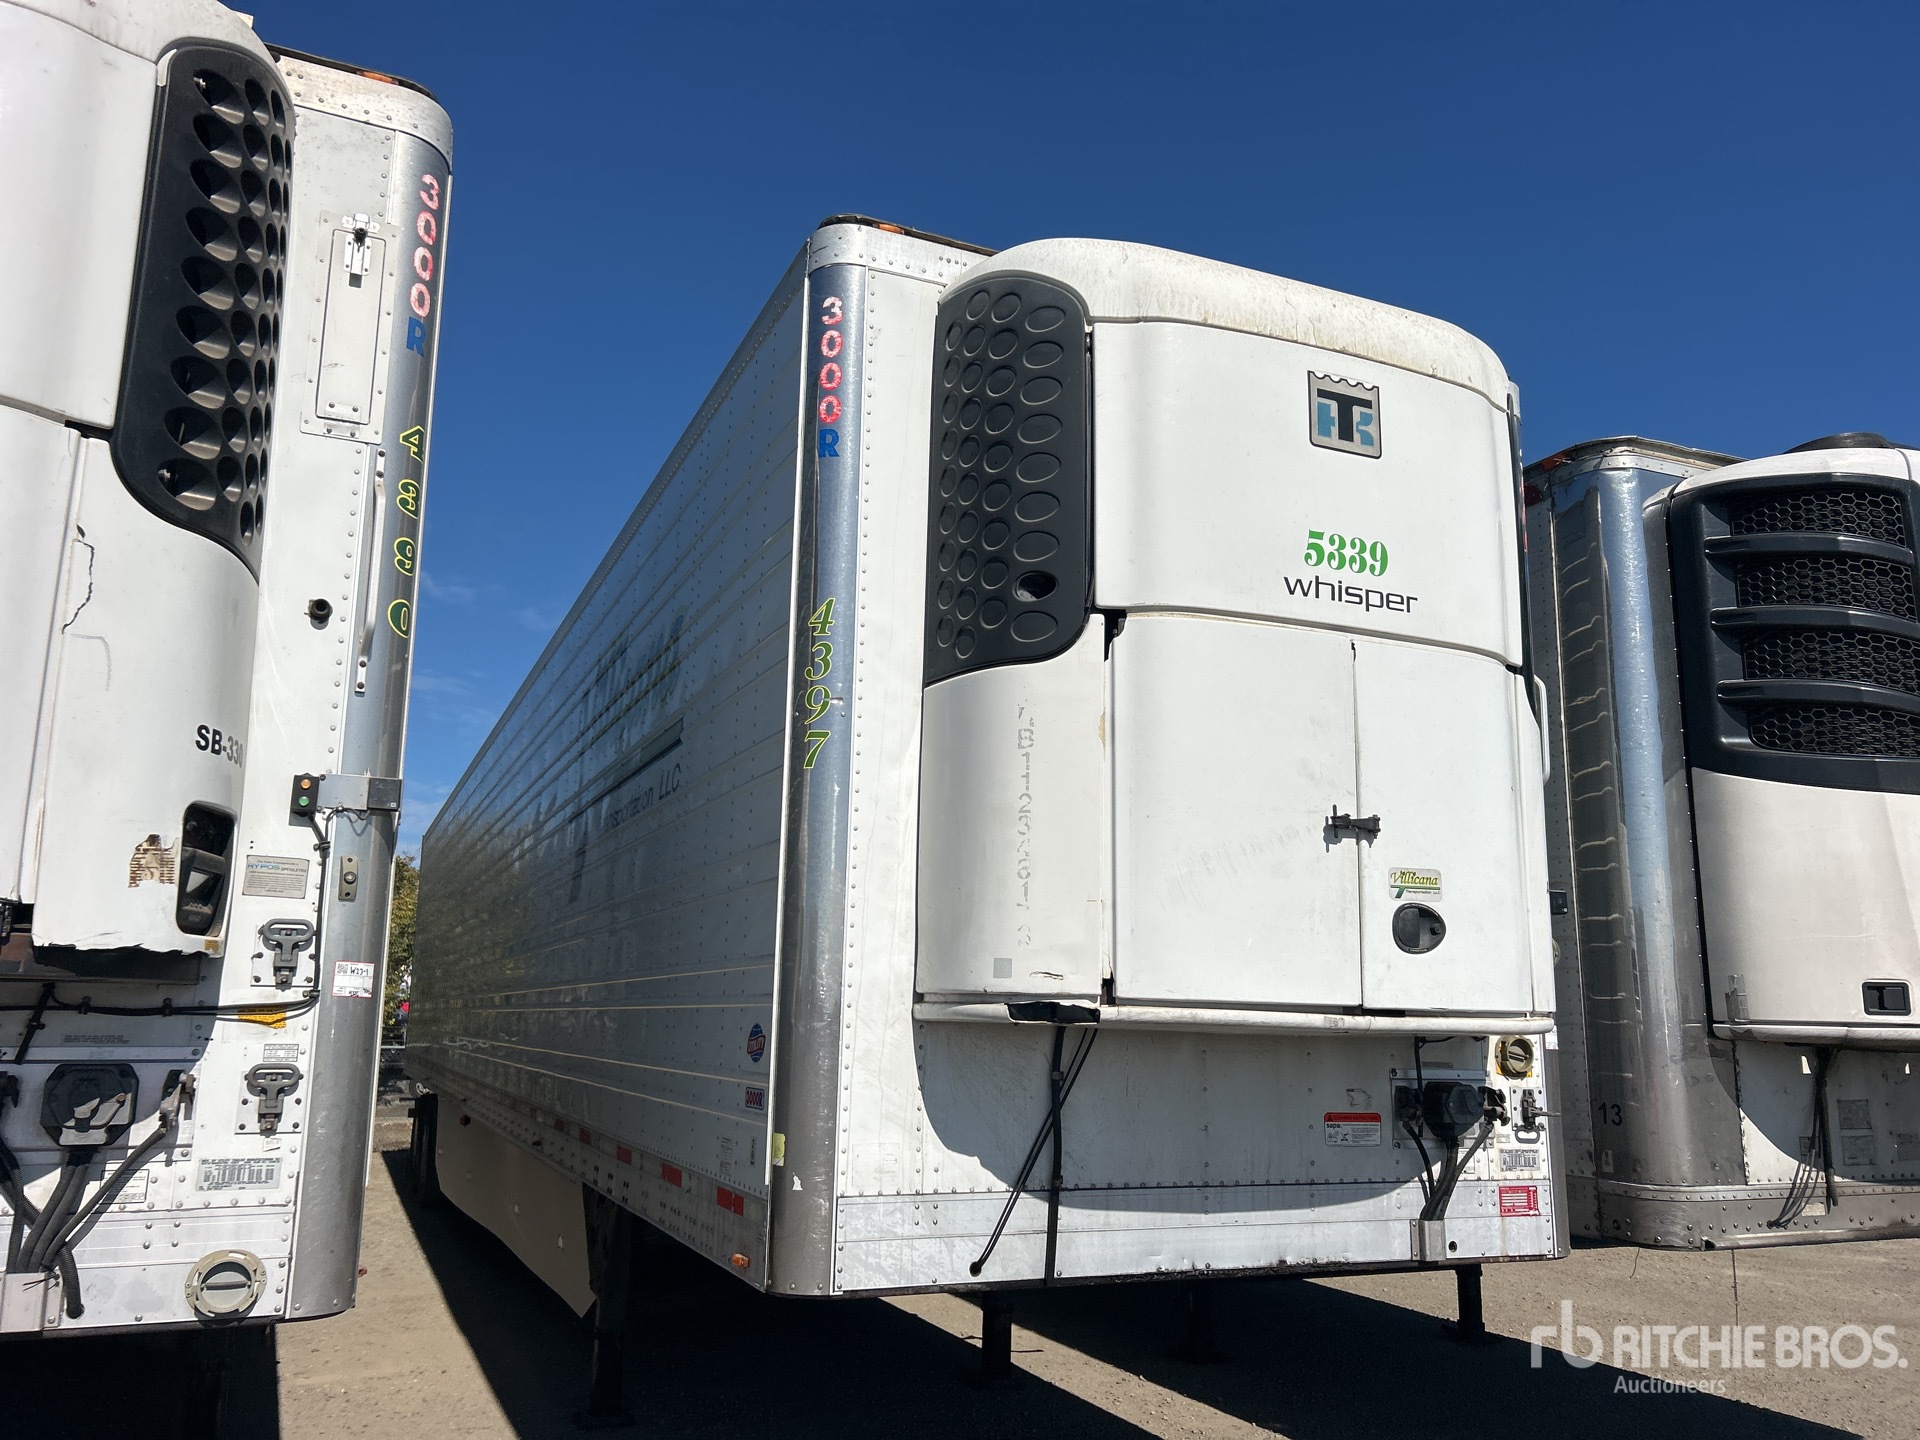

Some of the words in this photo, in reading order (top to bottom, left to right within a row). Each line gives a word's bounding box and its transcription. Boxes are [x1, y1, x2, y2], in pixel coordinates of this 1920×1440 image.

[406, 174, 440, 357] 3000R
[818, 296, 844, 459] 3000R
[1304, 529, 1389, 577] 5339
[1283, 575, 1418, 613] whisper
[803, 597, 836, 769] 4397
[658, 763, 682, 801] LLC
[1390, 870, 1439, 886] Villicana
[1598, 1102, 1623, 1127] 13
